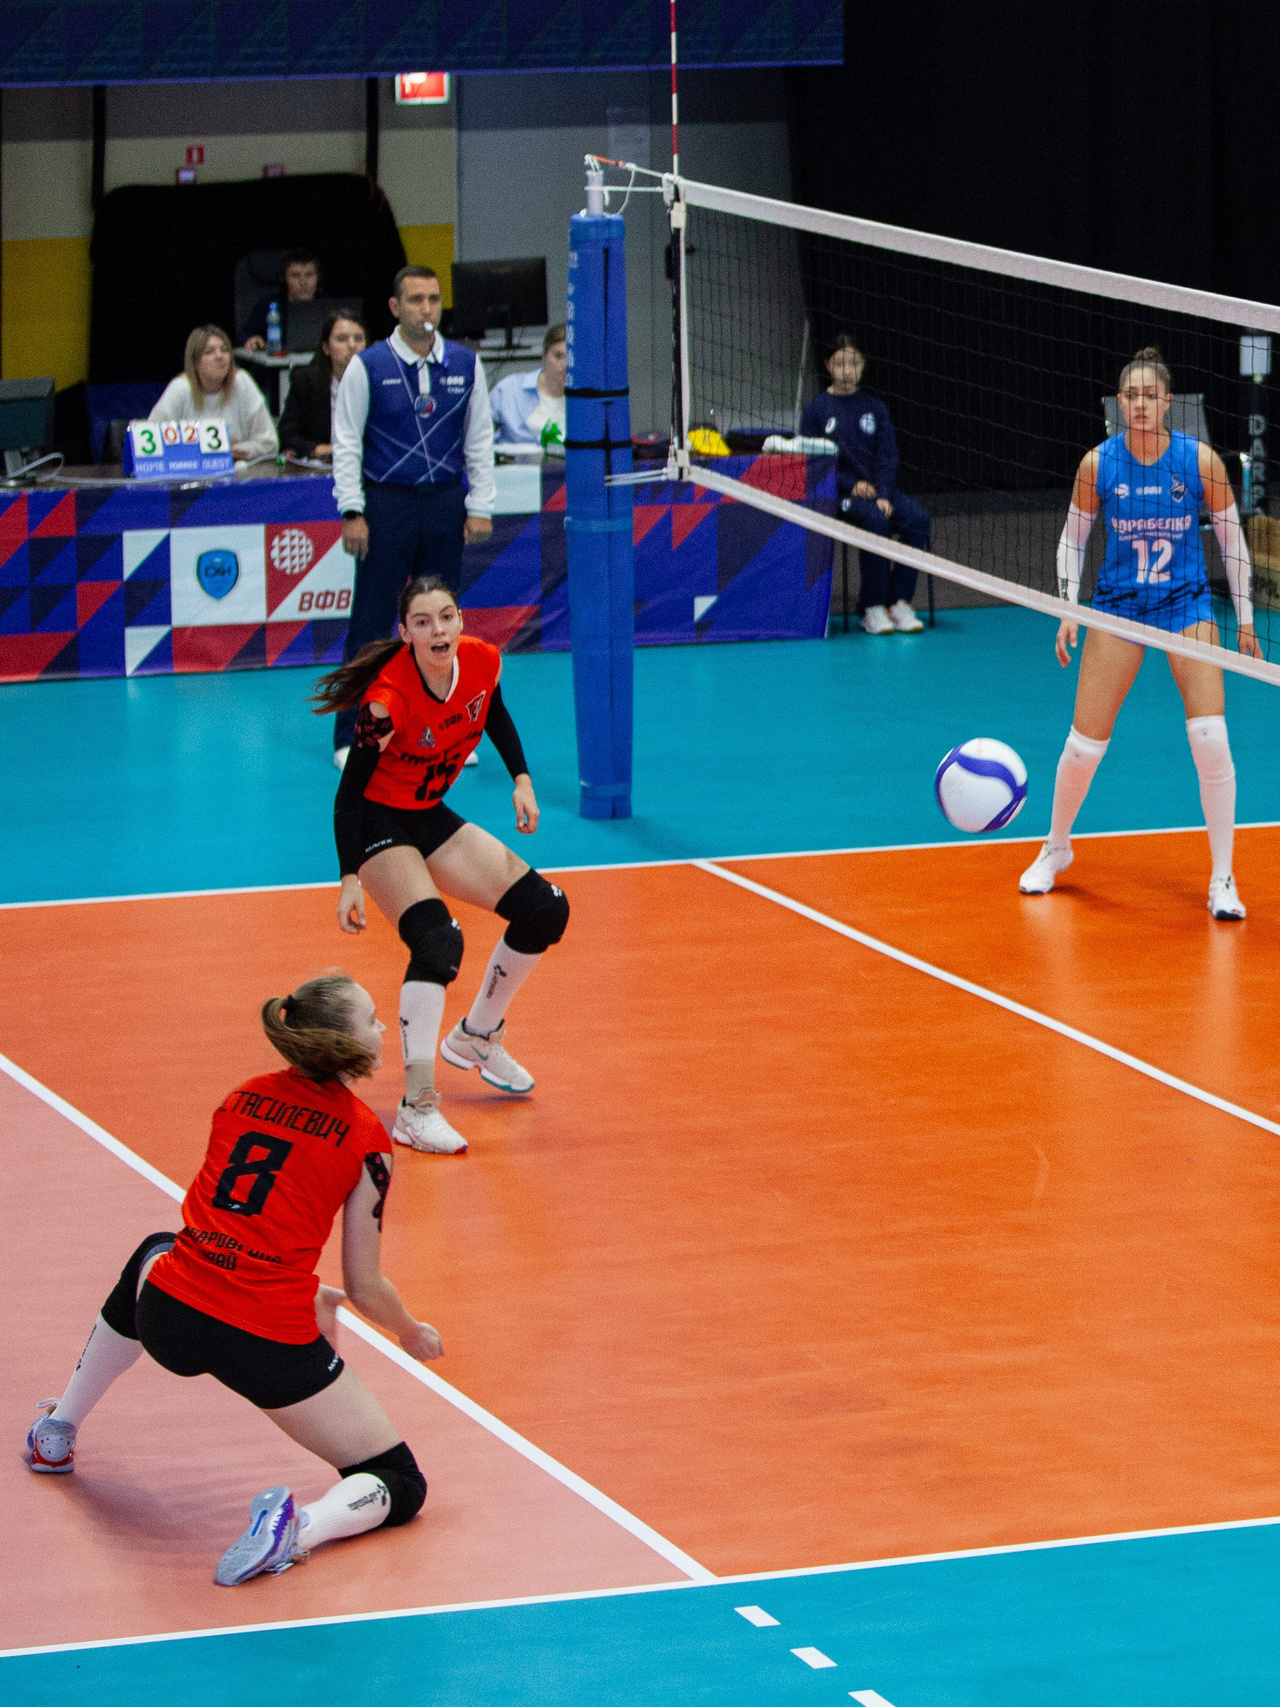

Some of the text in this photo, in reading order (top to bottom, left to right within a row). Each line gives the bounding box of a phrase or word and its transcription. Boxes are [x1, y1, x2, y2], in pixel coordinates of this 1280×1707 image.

[140, 426, 222, 455] 3 0 2 3
[1132, 539, 1172, 585] 12
[298, 590, 351, 613] ВФВ
[220, 1091, 350, 1147] ТАСИЛЕВИЧ
[212, 1131, 294, 1217] 8
